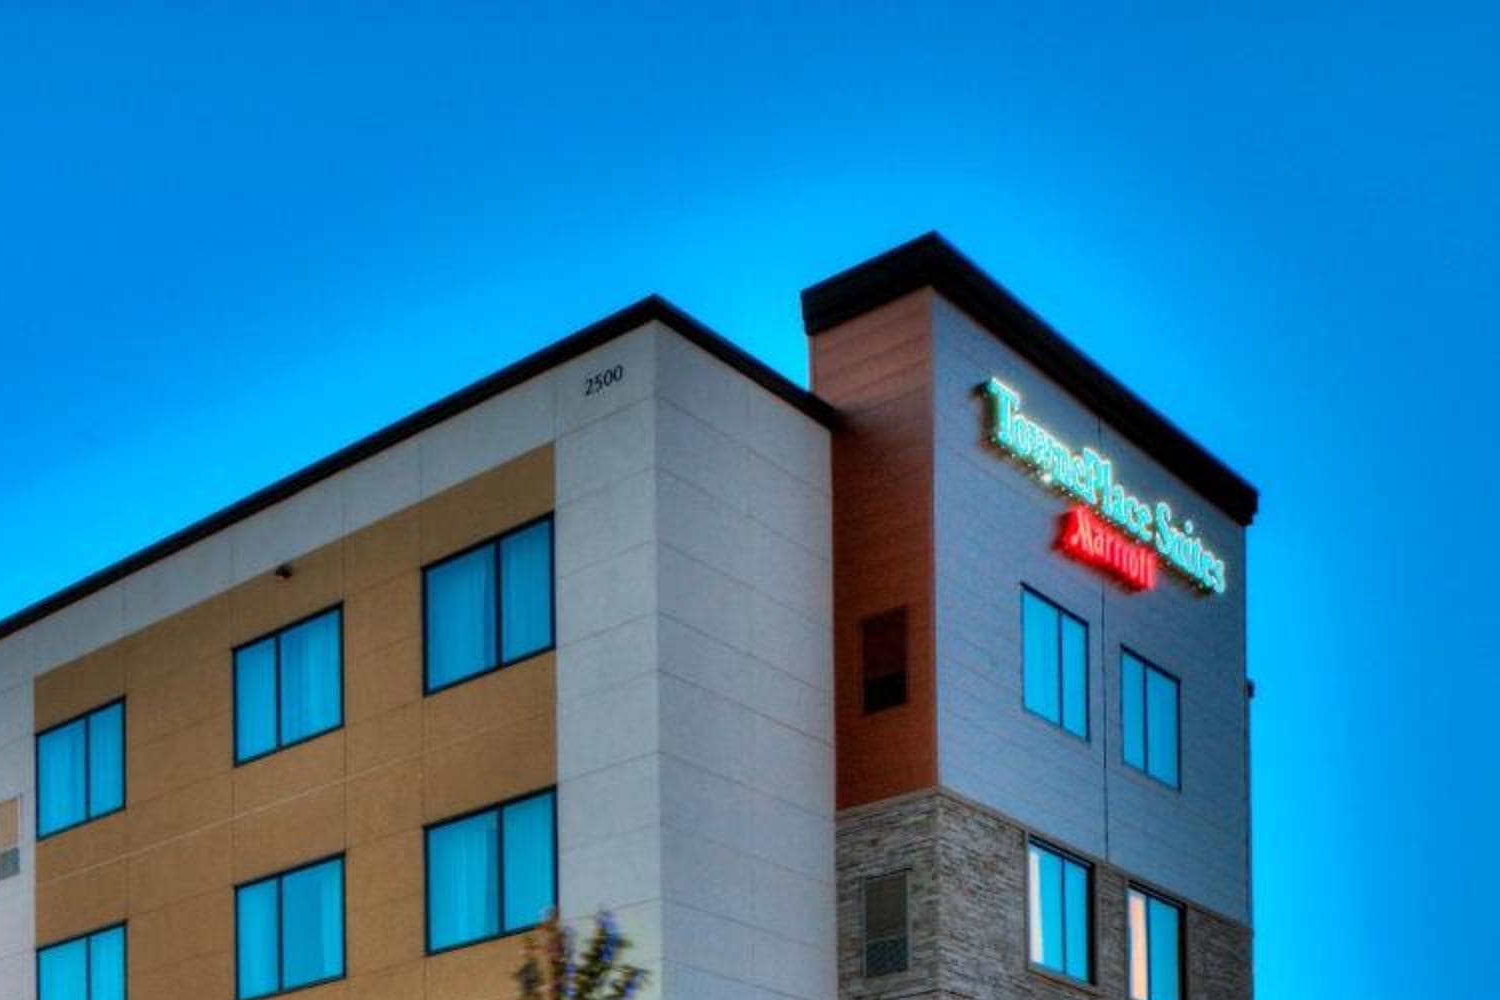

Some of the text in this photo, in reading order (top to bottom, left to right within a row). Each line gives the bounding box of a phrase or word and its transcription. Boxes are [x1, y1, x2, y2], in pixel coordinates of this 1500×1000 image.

[583, 364, 624, 396] 2500
[986, 376, 1226, 594] TownePlace Suites
[1071, 504, 1158, 589] Marriott
